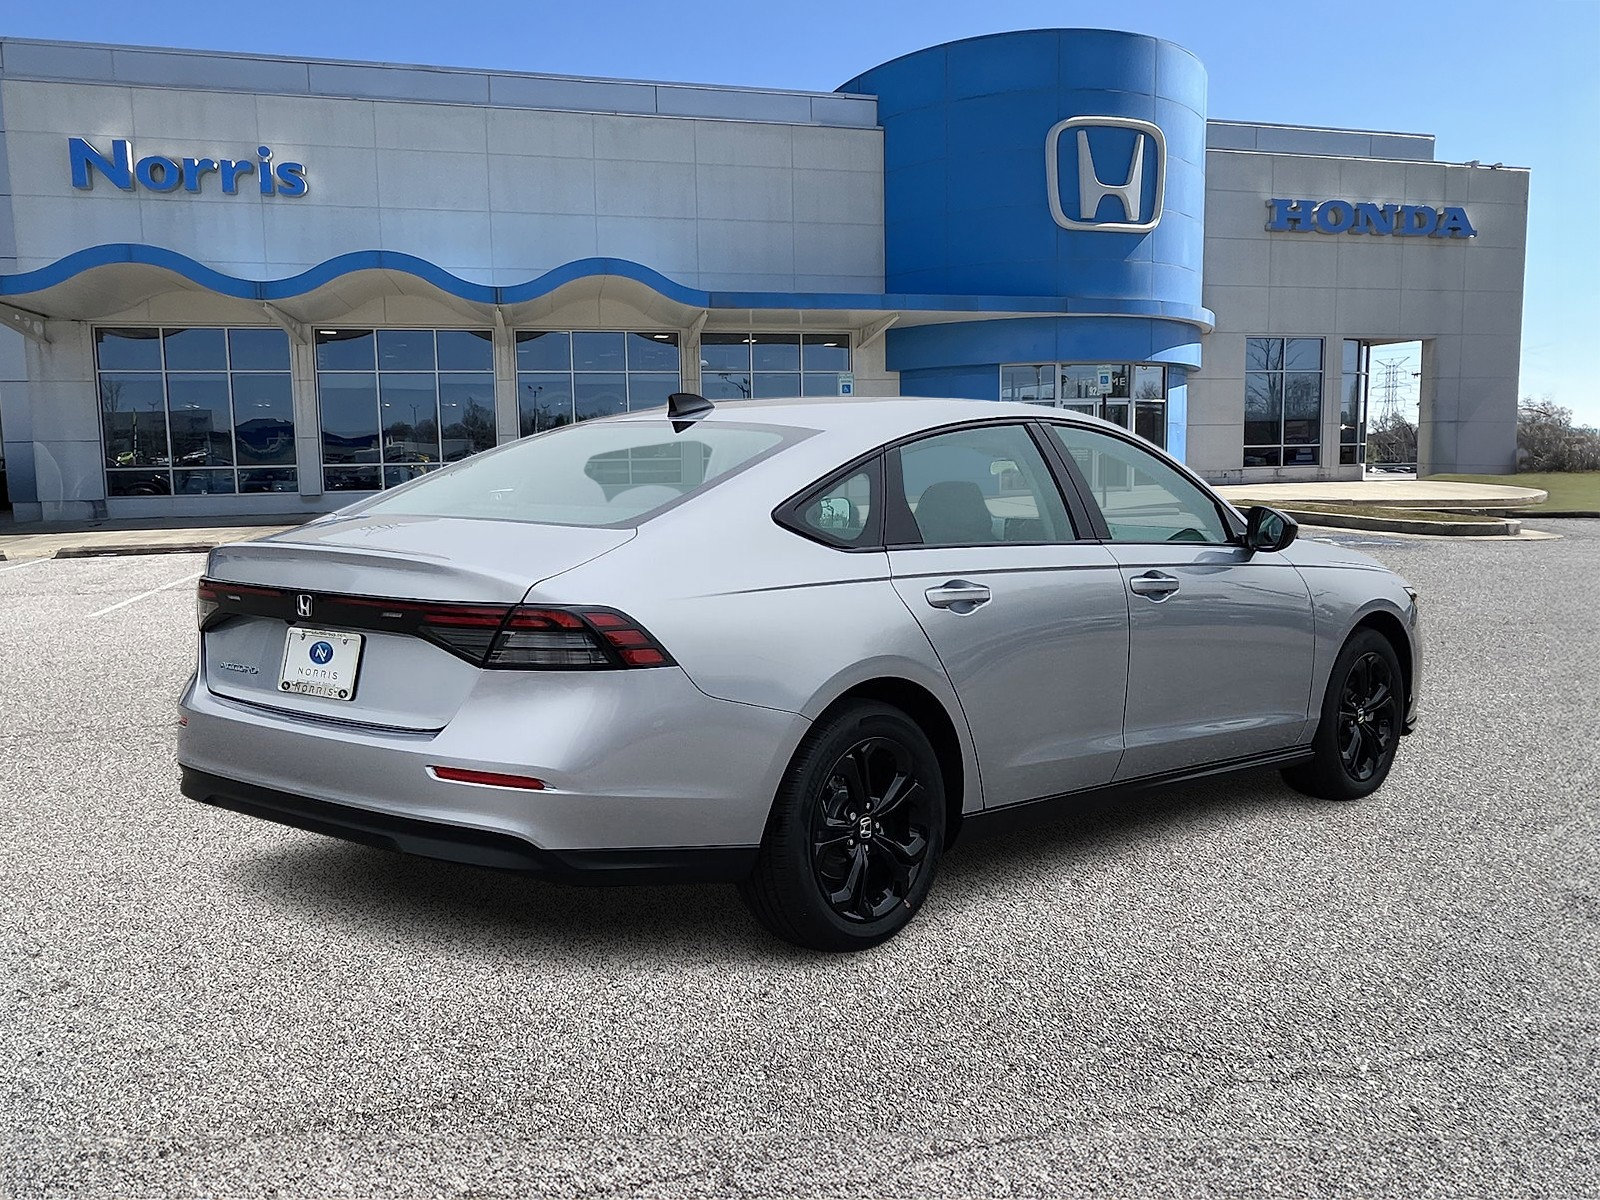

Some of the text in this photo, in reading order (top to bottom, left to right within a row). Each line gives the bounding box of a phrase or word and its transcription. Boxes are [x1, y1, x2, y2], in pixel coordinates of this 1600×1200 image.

[68, 137, 308, 197] Norris
[1265, 198, 1478, 239] HONDA
[297, 667, 339, 680] NORRIS
[294, 683, 334, 697] NORRIS
